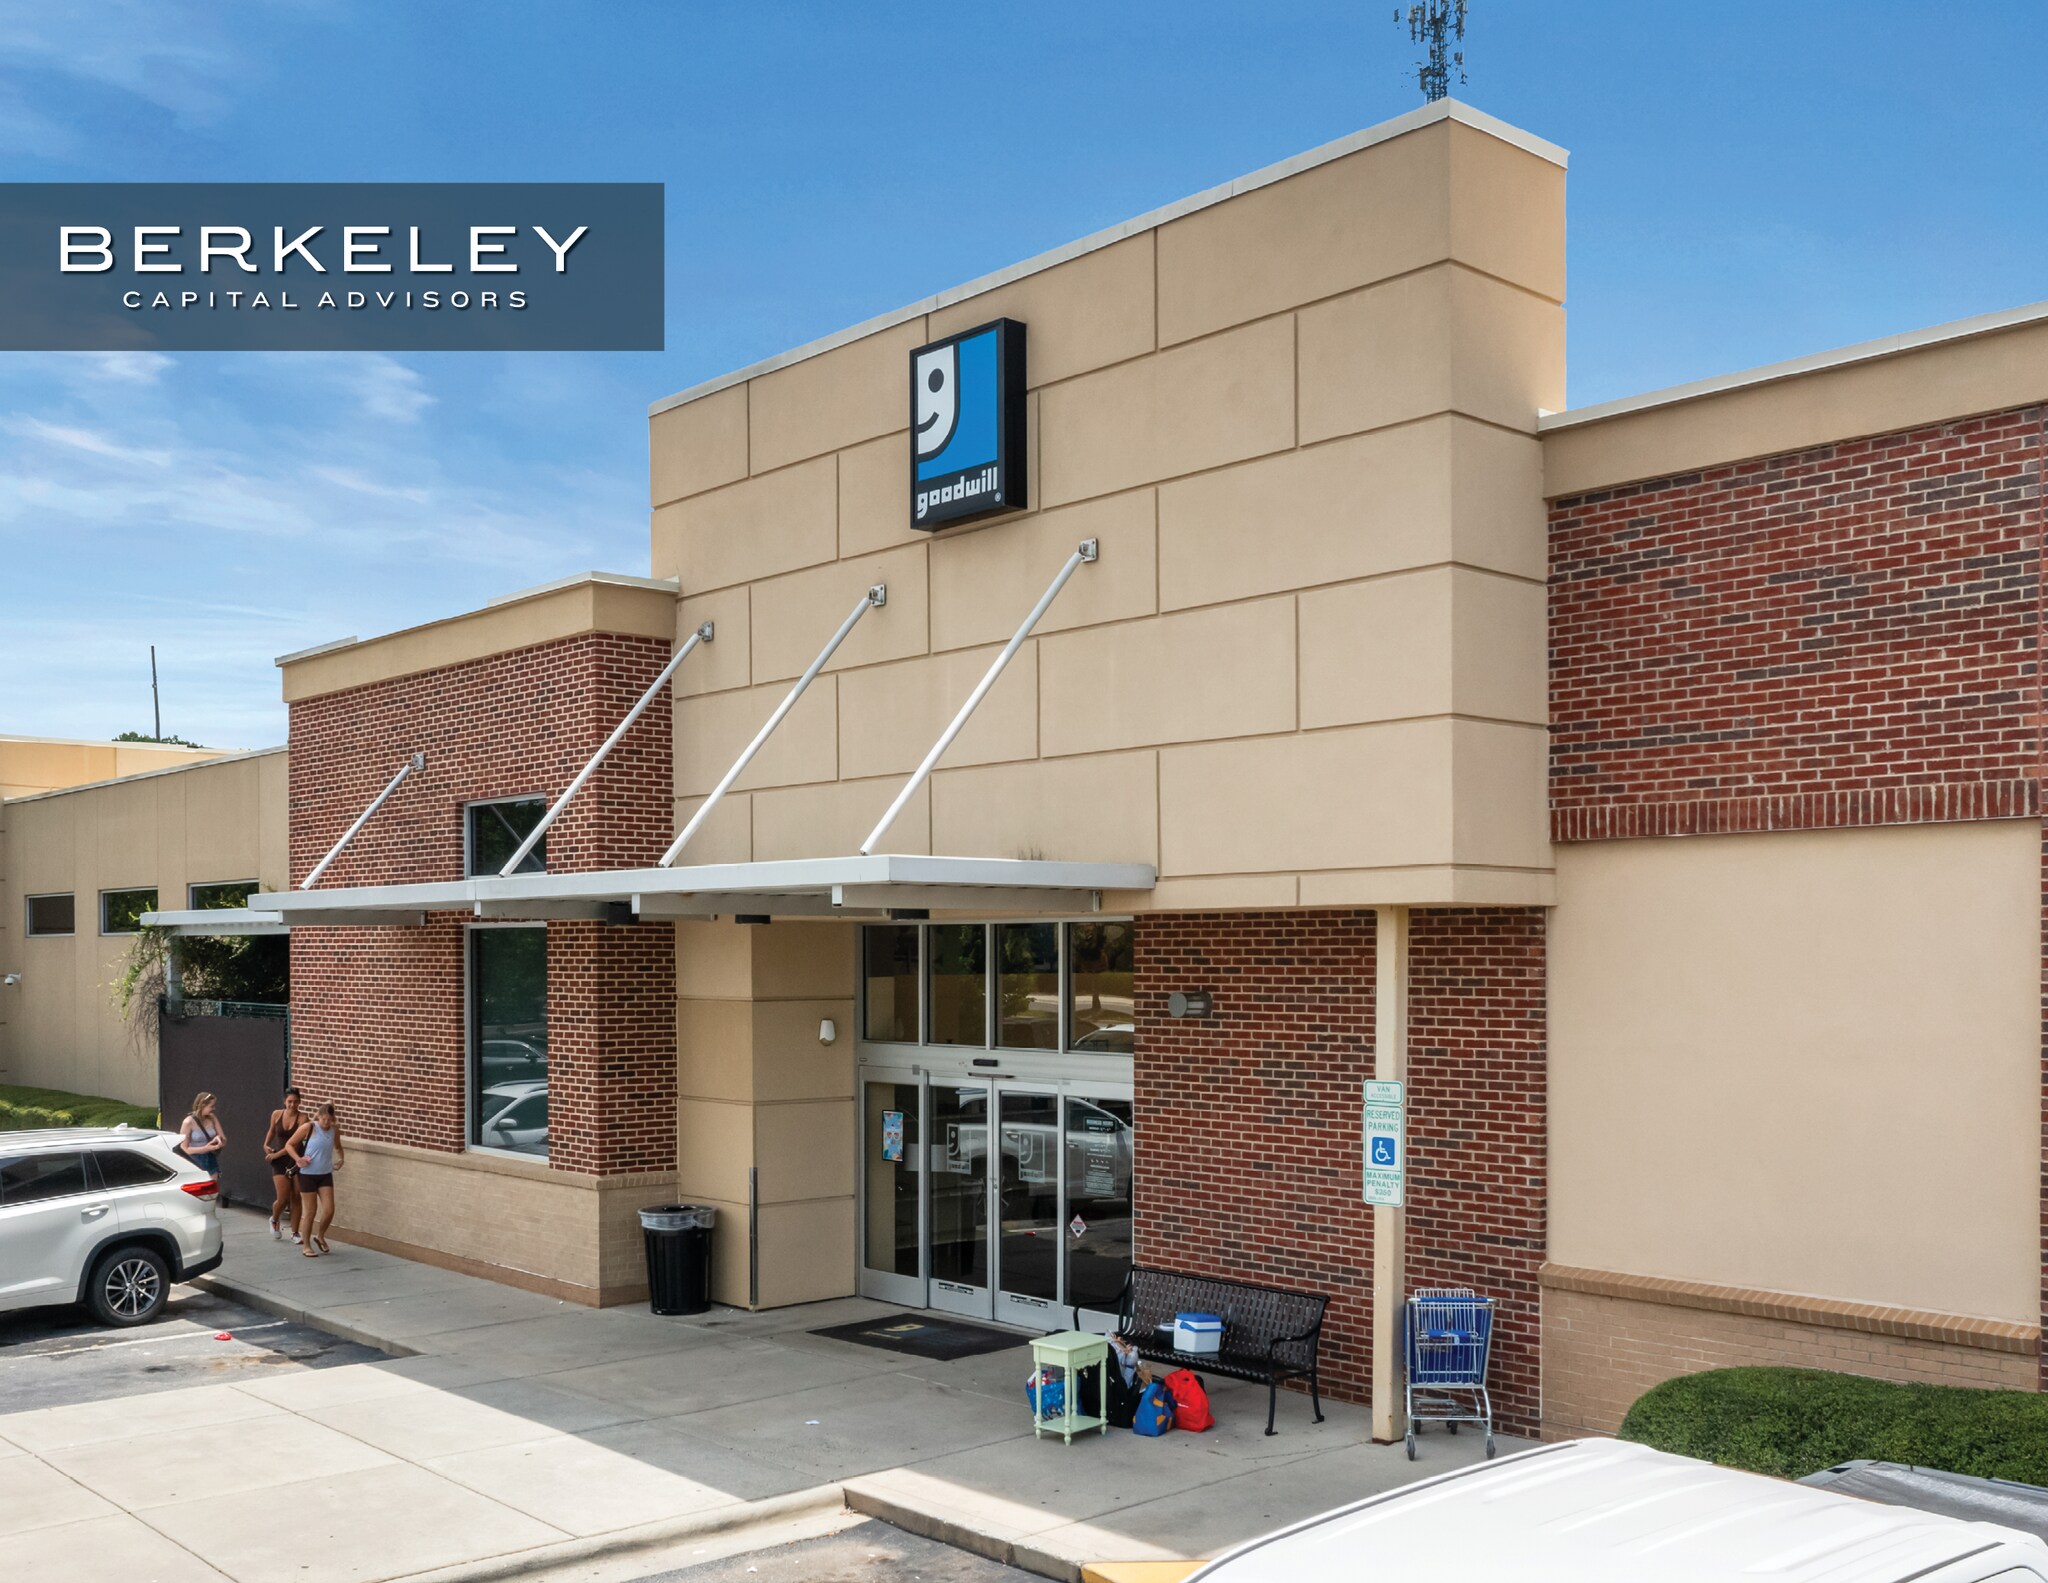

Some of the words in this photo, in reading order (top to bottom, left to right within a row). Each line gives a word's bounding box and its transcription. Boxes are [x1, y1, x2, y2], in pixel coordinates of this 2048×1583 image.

[916, 466, 998, 520] goodwill
[1366, 1109, 1400, 1121] RESERVED
[1368, 1121, 1399, 1133] PARKING
[1366, 1171, 1400, 1181] MAXIMUM
[1366, 1180, 1400, 1189] PENALTY
